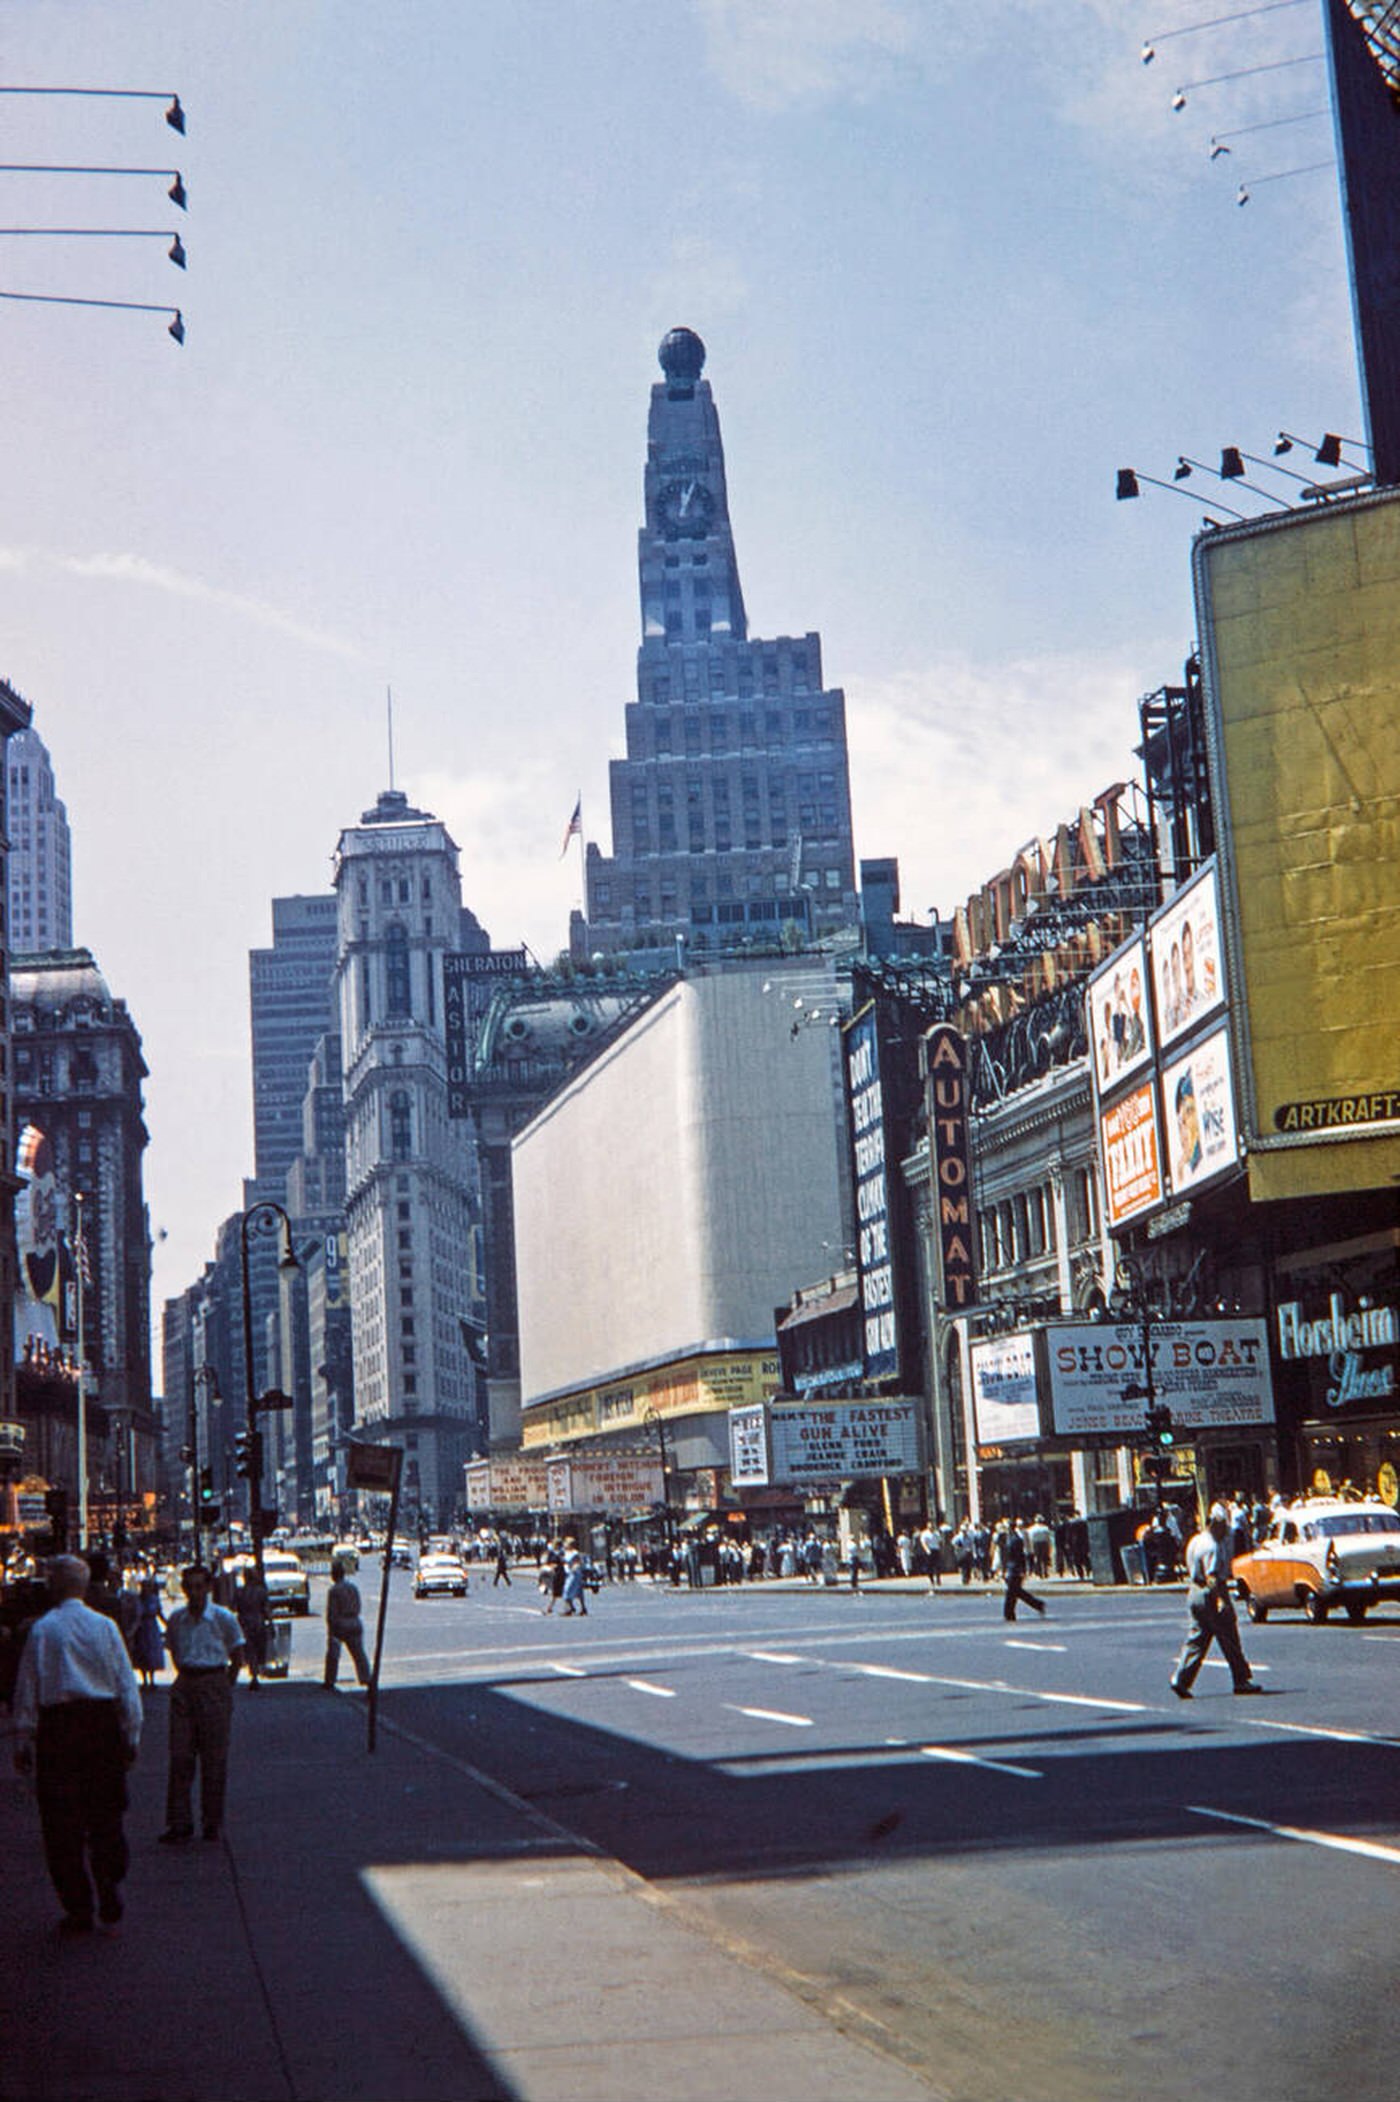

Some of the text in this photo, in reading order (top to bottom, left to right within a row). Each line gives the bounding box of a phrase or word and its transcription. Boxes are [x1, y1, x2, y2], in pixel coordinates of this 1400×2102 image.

[444, 953, 525, 972] SHERATON
[448, 986, 465, 1111] ASTOR
[933, 1034, 970, 1304] AUTOMAT
[1278, 1292, 1394, 1360] Florsheim
[1057, 1343, 1159, 1373] SHOW
[1173, 1338, 1260, 1367] BOAT
[800, 1423, 888, 1441] GUN ALIVE
[811, 1411, 836, 1425] THE
[849, 1406, 912, 1423] FASTEST
